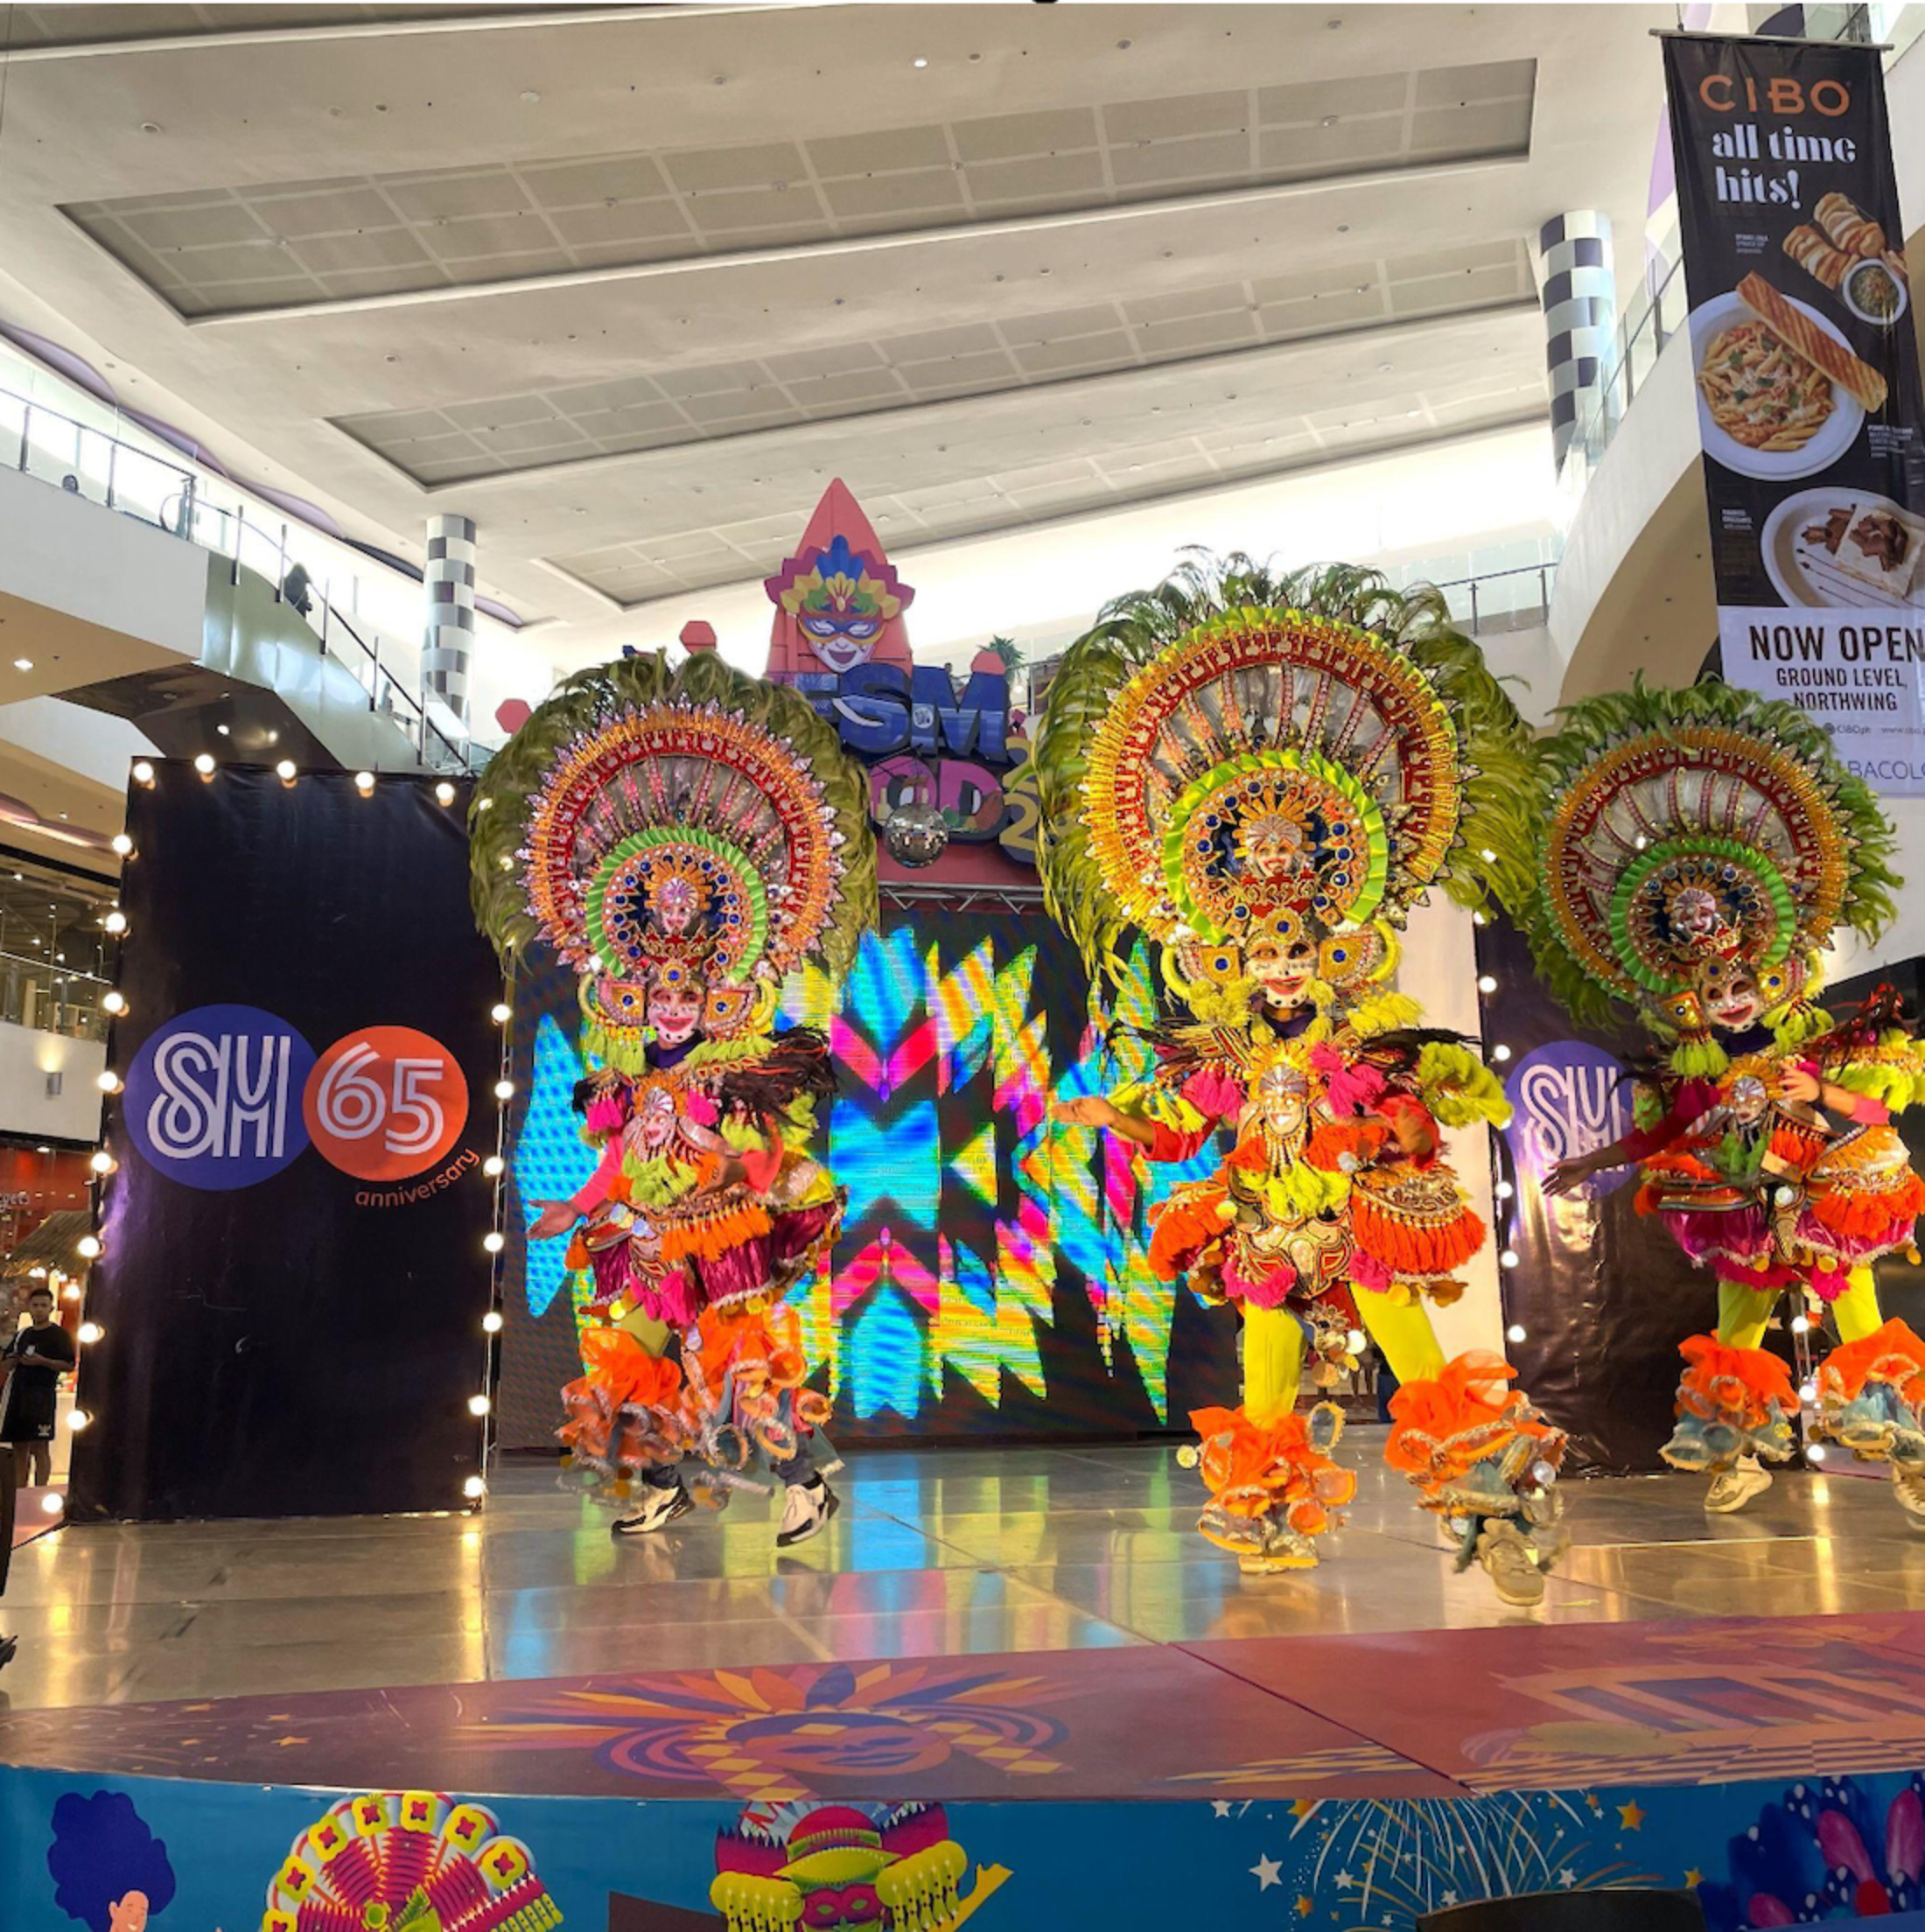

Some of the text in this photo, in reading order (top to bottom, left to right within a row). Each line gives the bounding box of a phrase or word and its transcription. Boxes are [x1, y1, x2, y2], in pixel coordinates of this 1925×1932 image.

[1699, 74, 1850, 116] CIBO
[1712, 123, 1856, 163] all time
[1715, 165, 1801, 209] hits!
[1749, 626, 1925, 662] NOW OPEN
[1776, 668, 1908, 689] GROUND LEVEL,
[837, 662, 1007, 760] SM
[1793, 692, 1898, 710] NORTHWING
[1847, 760, 1925, 780] BACOL
[147, 1032, 444, 1159] SM 65
[1520, 1064, 1622, 1172] SM
[354, 1148, 480, 1208] anniversary
